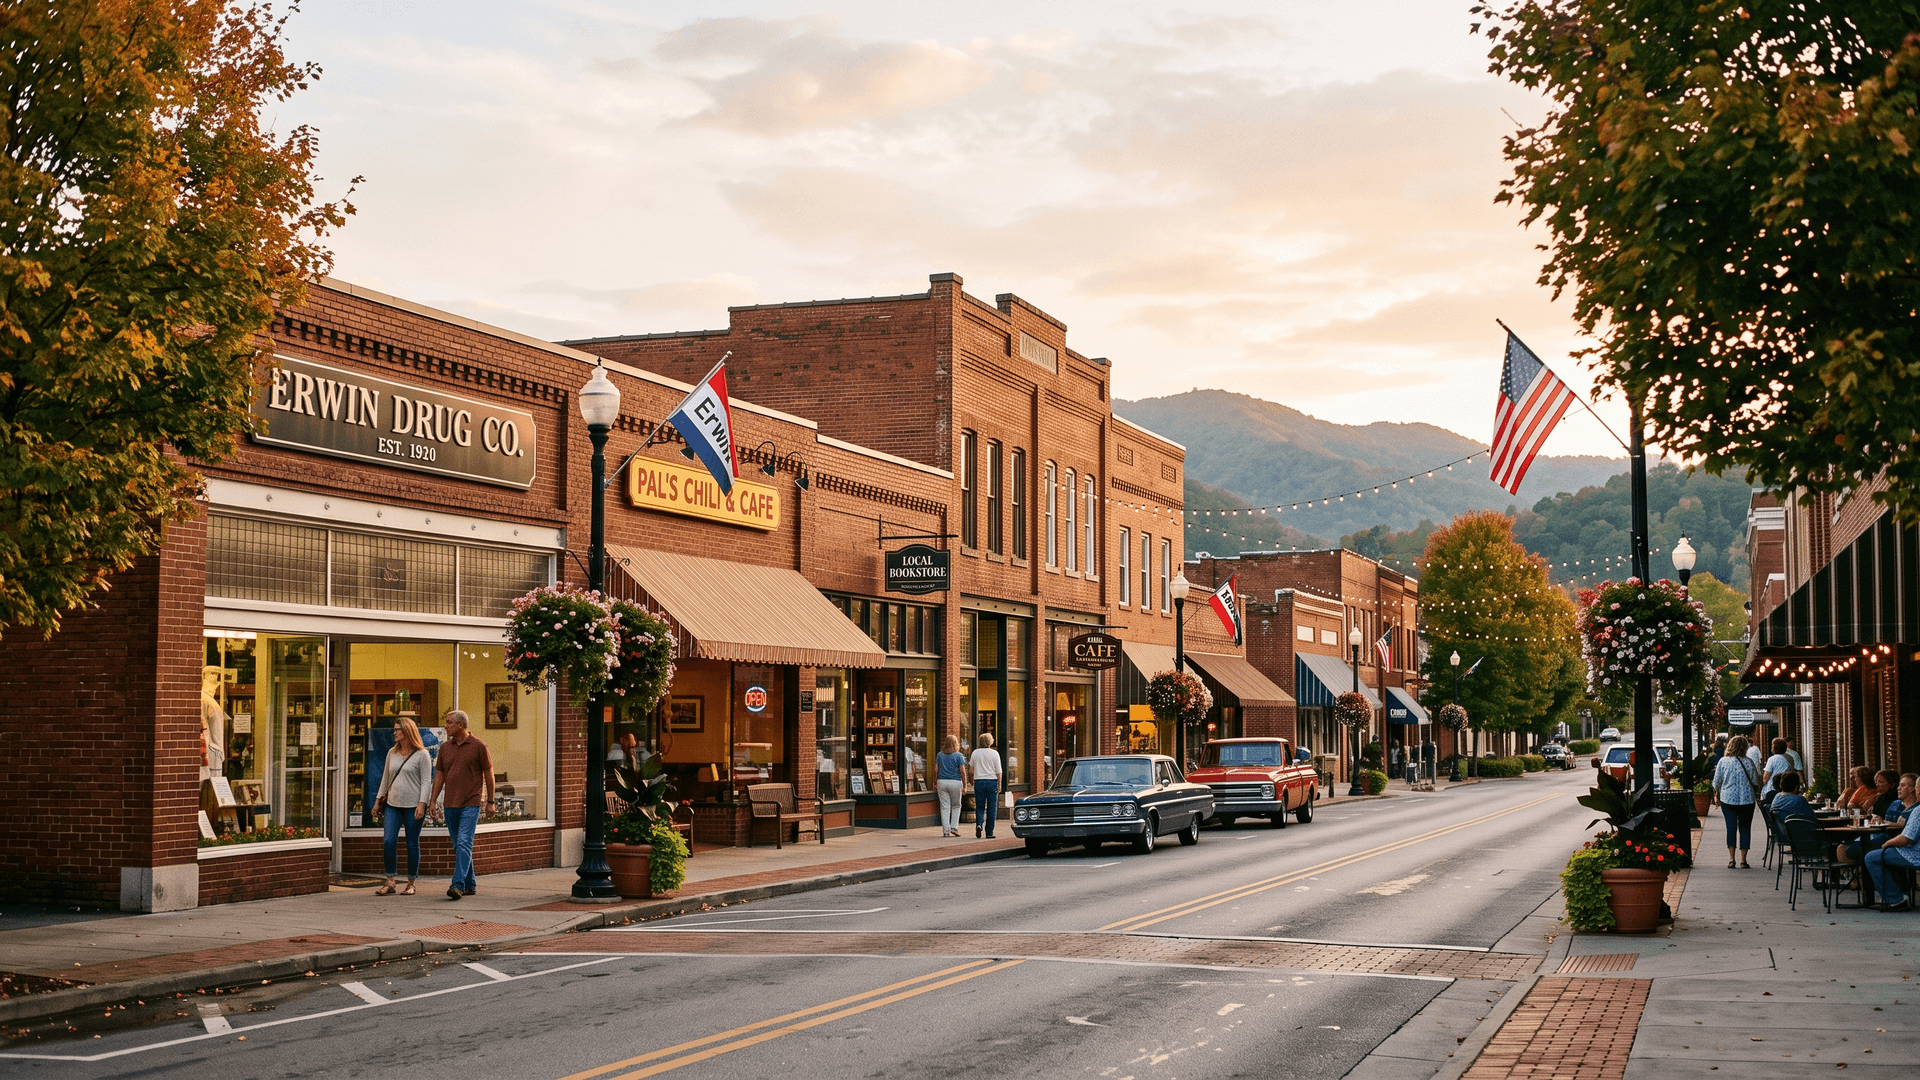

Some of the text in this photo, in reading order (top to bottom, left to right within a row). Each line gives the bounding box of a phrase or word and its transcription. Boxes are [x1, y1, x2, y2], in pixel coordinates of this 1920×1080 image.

[269, 367, 524, 457] ERWIN DRUG CO.
[378, 437, 436, 462] EST. 1920
[637, 467, 773, 520] PAL'S CHILI & CAFE
[902, 555, 933, 566] LOCAL
[889, 567, 947, 578] BOOKSTORE
[1074, 643, 1117, 658] CAFE
[745, 692, 767, 706] OPEN
